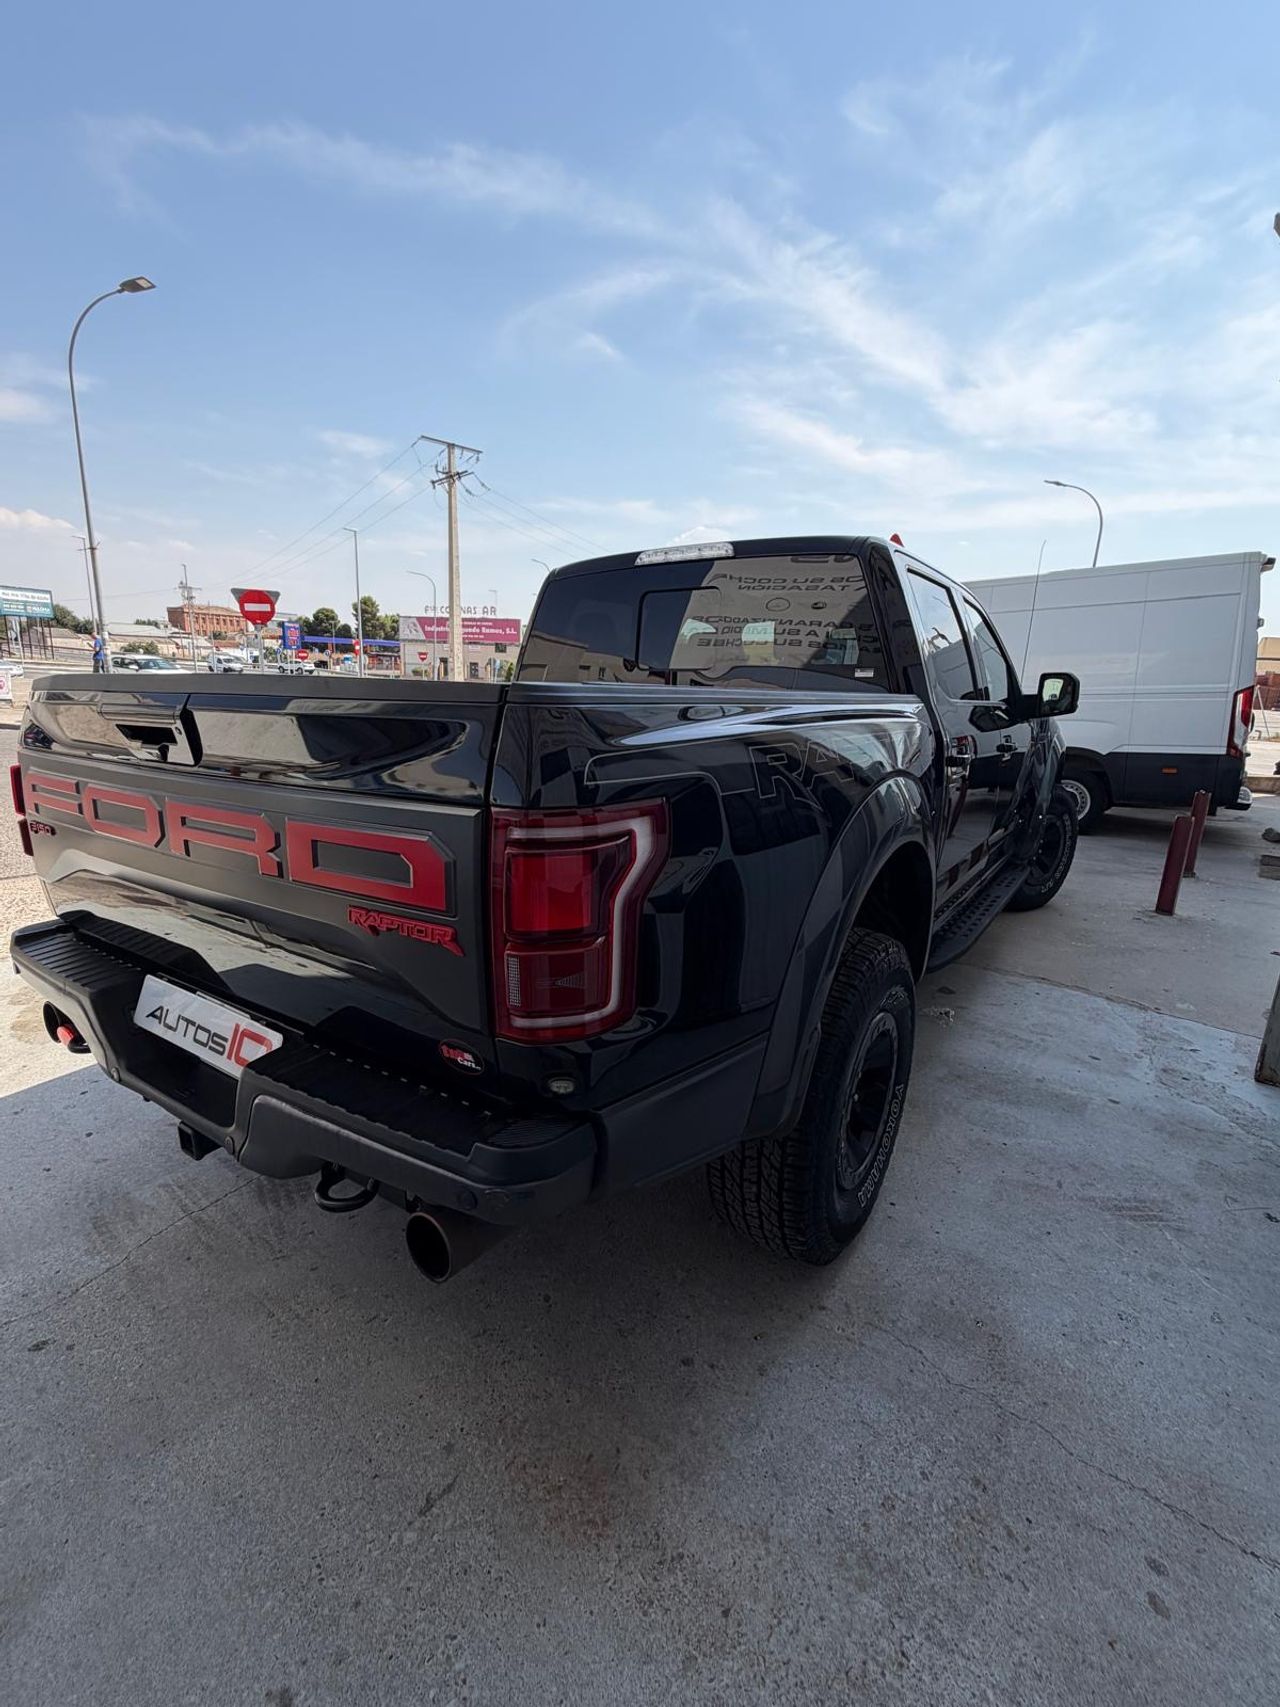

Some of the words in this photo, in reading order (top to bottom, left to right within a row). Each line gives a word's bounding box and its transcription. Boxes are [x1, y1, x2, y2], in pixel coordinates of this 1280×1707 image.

[440, 605, 477, 615] CONAS
[25, 772, 450, 912] FORD
[348, 904, 465, 957] RAPTOR
